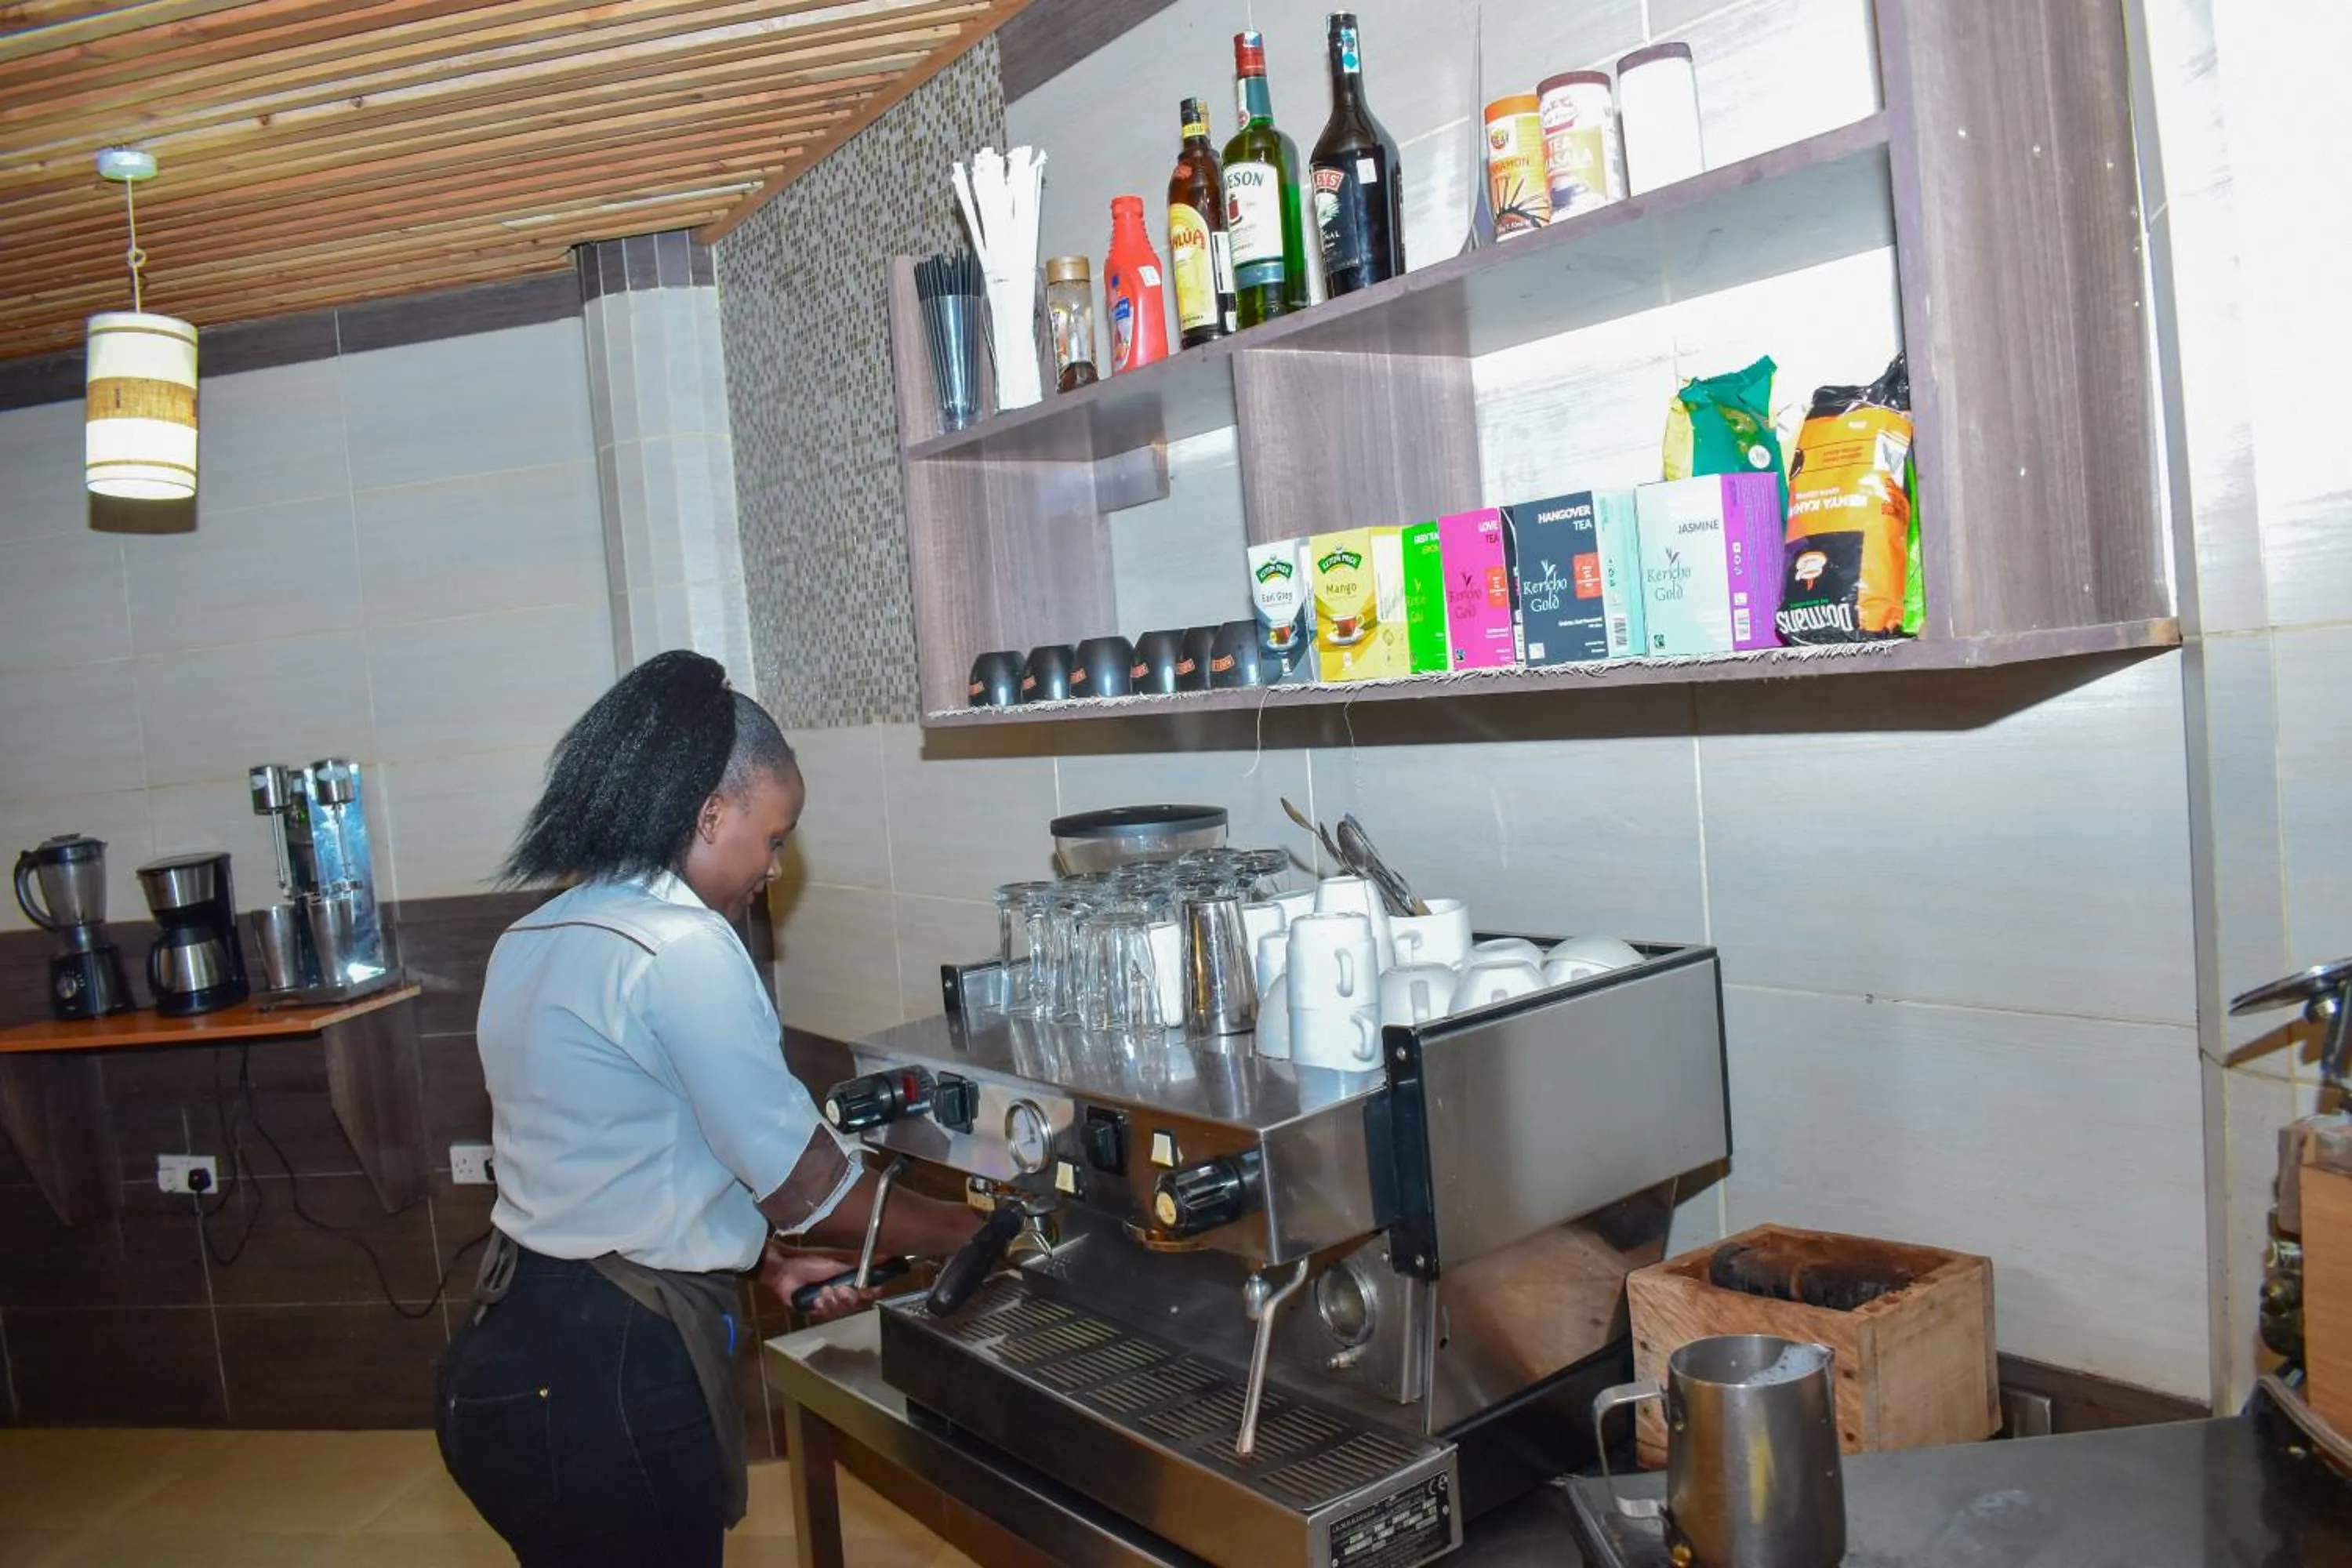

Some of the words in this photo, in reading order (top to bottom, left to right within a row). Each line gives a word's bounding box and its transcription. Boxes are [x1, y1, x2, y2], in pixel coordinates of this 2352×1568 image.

[1224, 171, 1264, 188] ESON
[1537, 504, 1592, 524] HANGOVER
[1478, 520, 1498, 532] LOVE
[1573, 519, 1592, 531] TEA
[1678, 519, 1719, 535] JASMINE
[1485, 534, 1500, 543] TEA
[1646, 561, 1691, 583] Kericho
[1326, 583, 1357, 595] Mango
[1523, 572, 1567, 595] Kericho
[1655, 580, 1683, 601] Gold
[1530, 589, 1559, 612] Gold
[1776, 603, 1854, 634] Dormans
